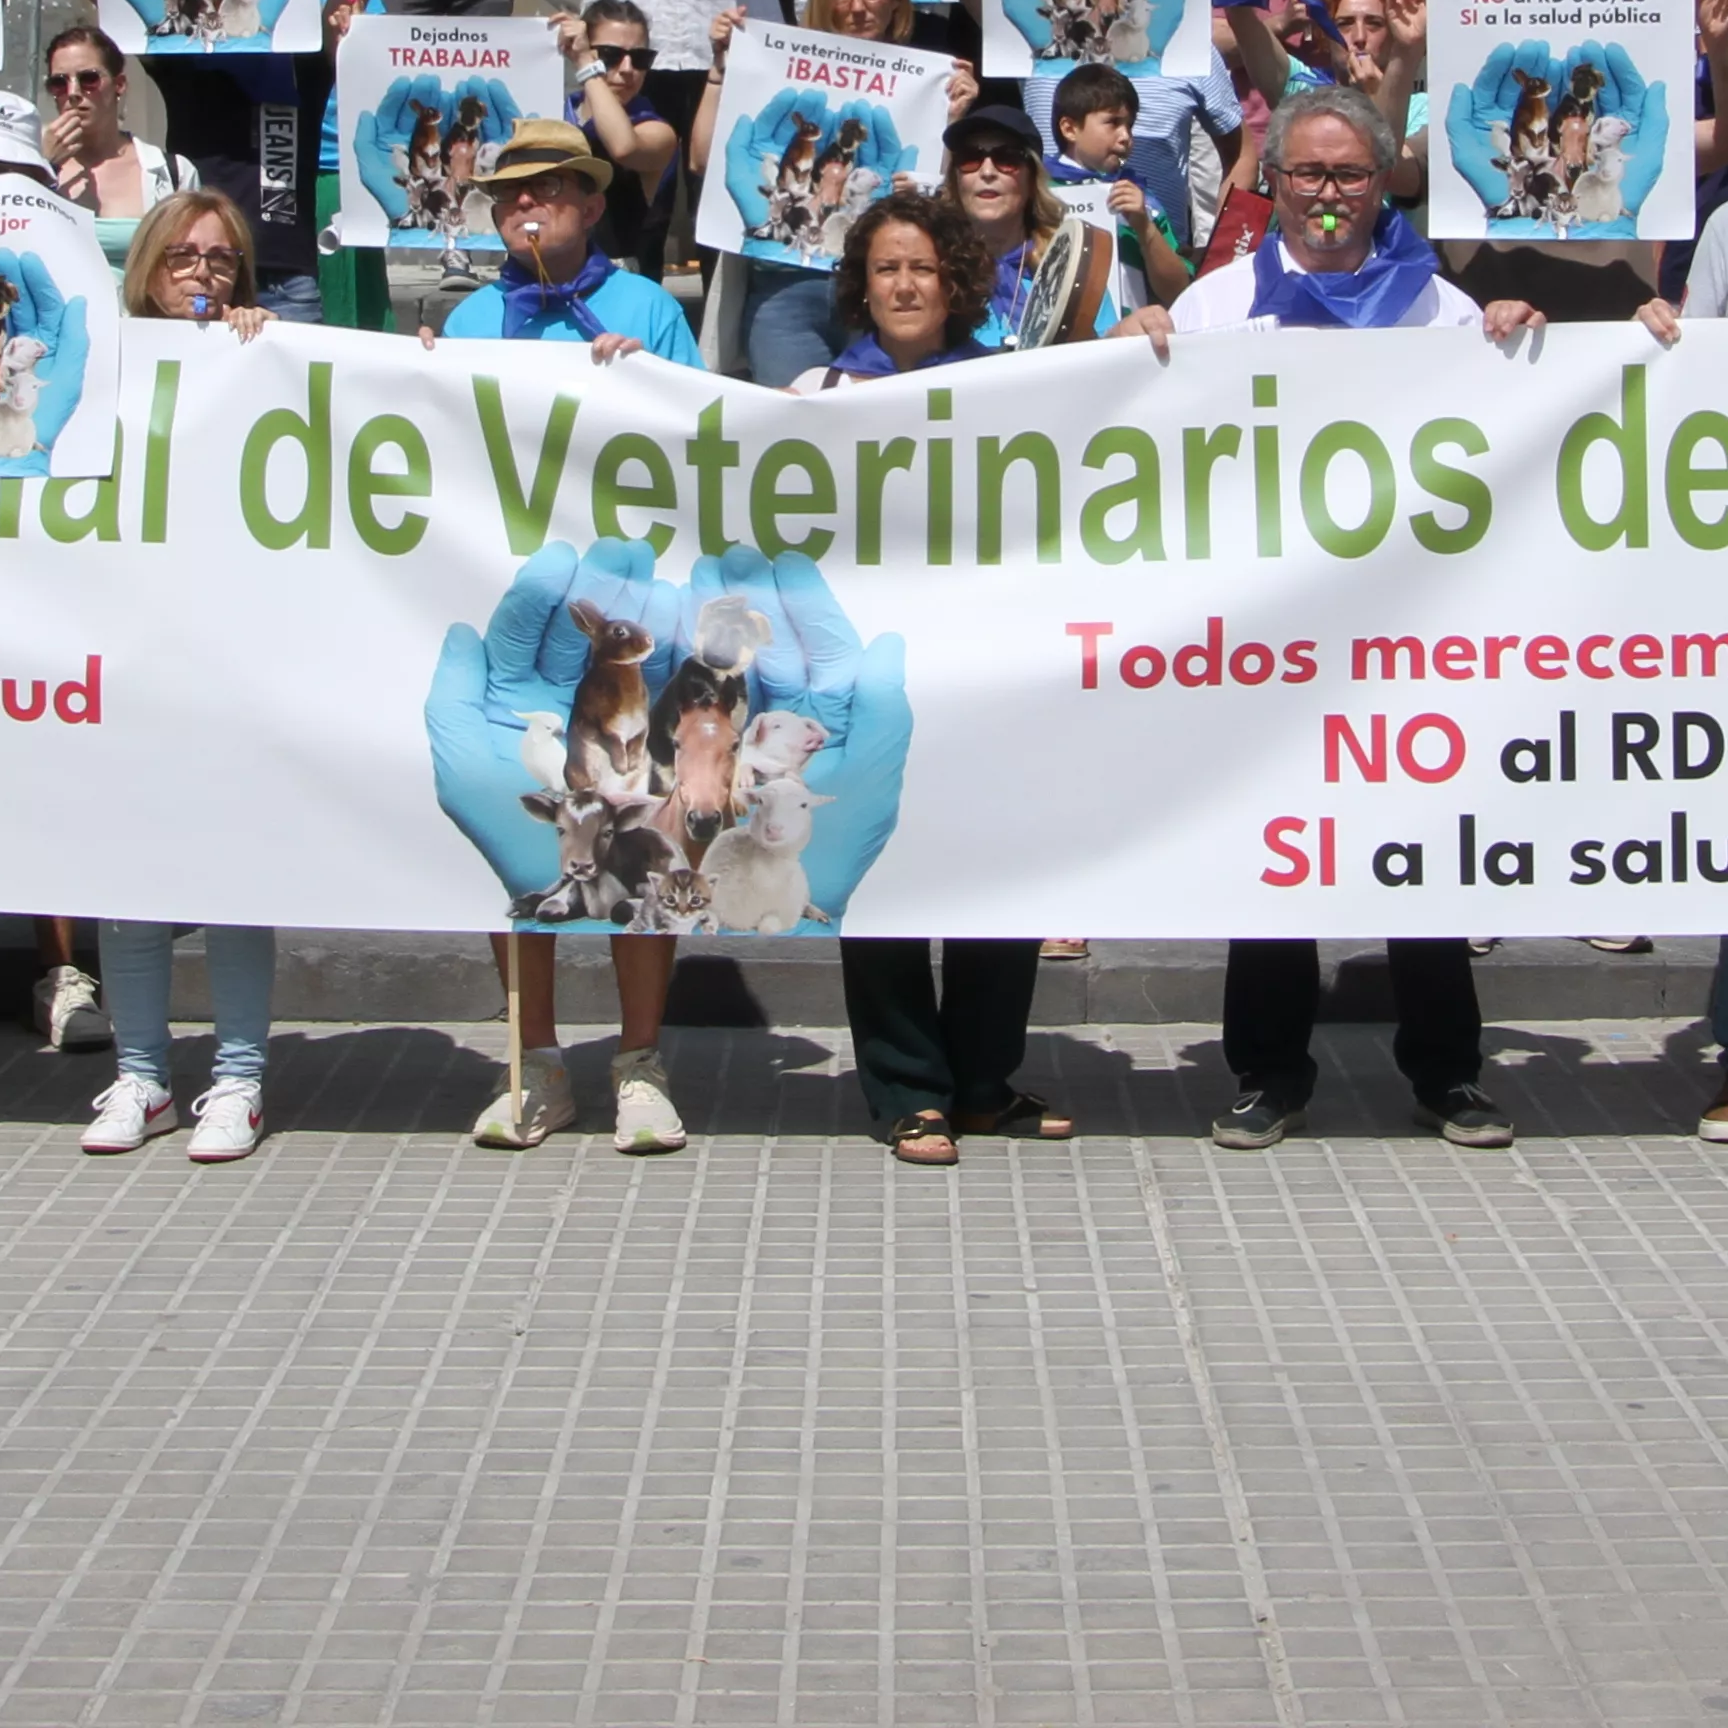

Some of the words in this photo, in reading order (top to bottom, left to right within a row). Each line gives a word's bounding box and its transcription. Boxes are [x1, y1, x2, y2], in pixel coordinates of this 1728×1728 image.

[411, 27, 488, 46] Dejadnos
[1460, 9, 1478, 25] SI
[1485, 13, 1497, 25] a
[1504, 8, 1521, 25] la
[1529, 8, 1582, 24] salud
[1589, 7, 1661, 29] pública
[389, 48, 510, 68] TRABAJAR
[764, 33, 785, 50] La
[791, 41, 886, 69] veterinaria
[891, 58, 925, 76] dice
[786, 56, 897, 97] ¡BASTA!
[239, 360, 433, 557] de
[471, 373, 1494, 567] Veterinarios
[1065, 616, 1319, 690] Todos
[1322, 712, 1467, 784] NO
[1500, 710, 1577, 783] al
[1612, 709, 1726, 781] RD
[1259, 815, 1336, 887] SI
[1372, 841, 1424, 887] a
[1459, 814, 1535, 887] la
